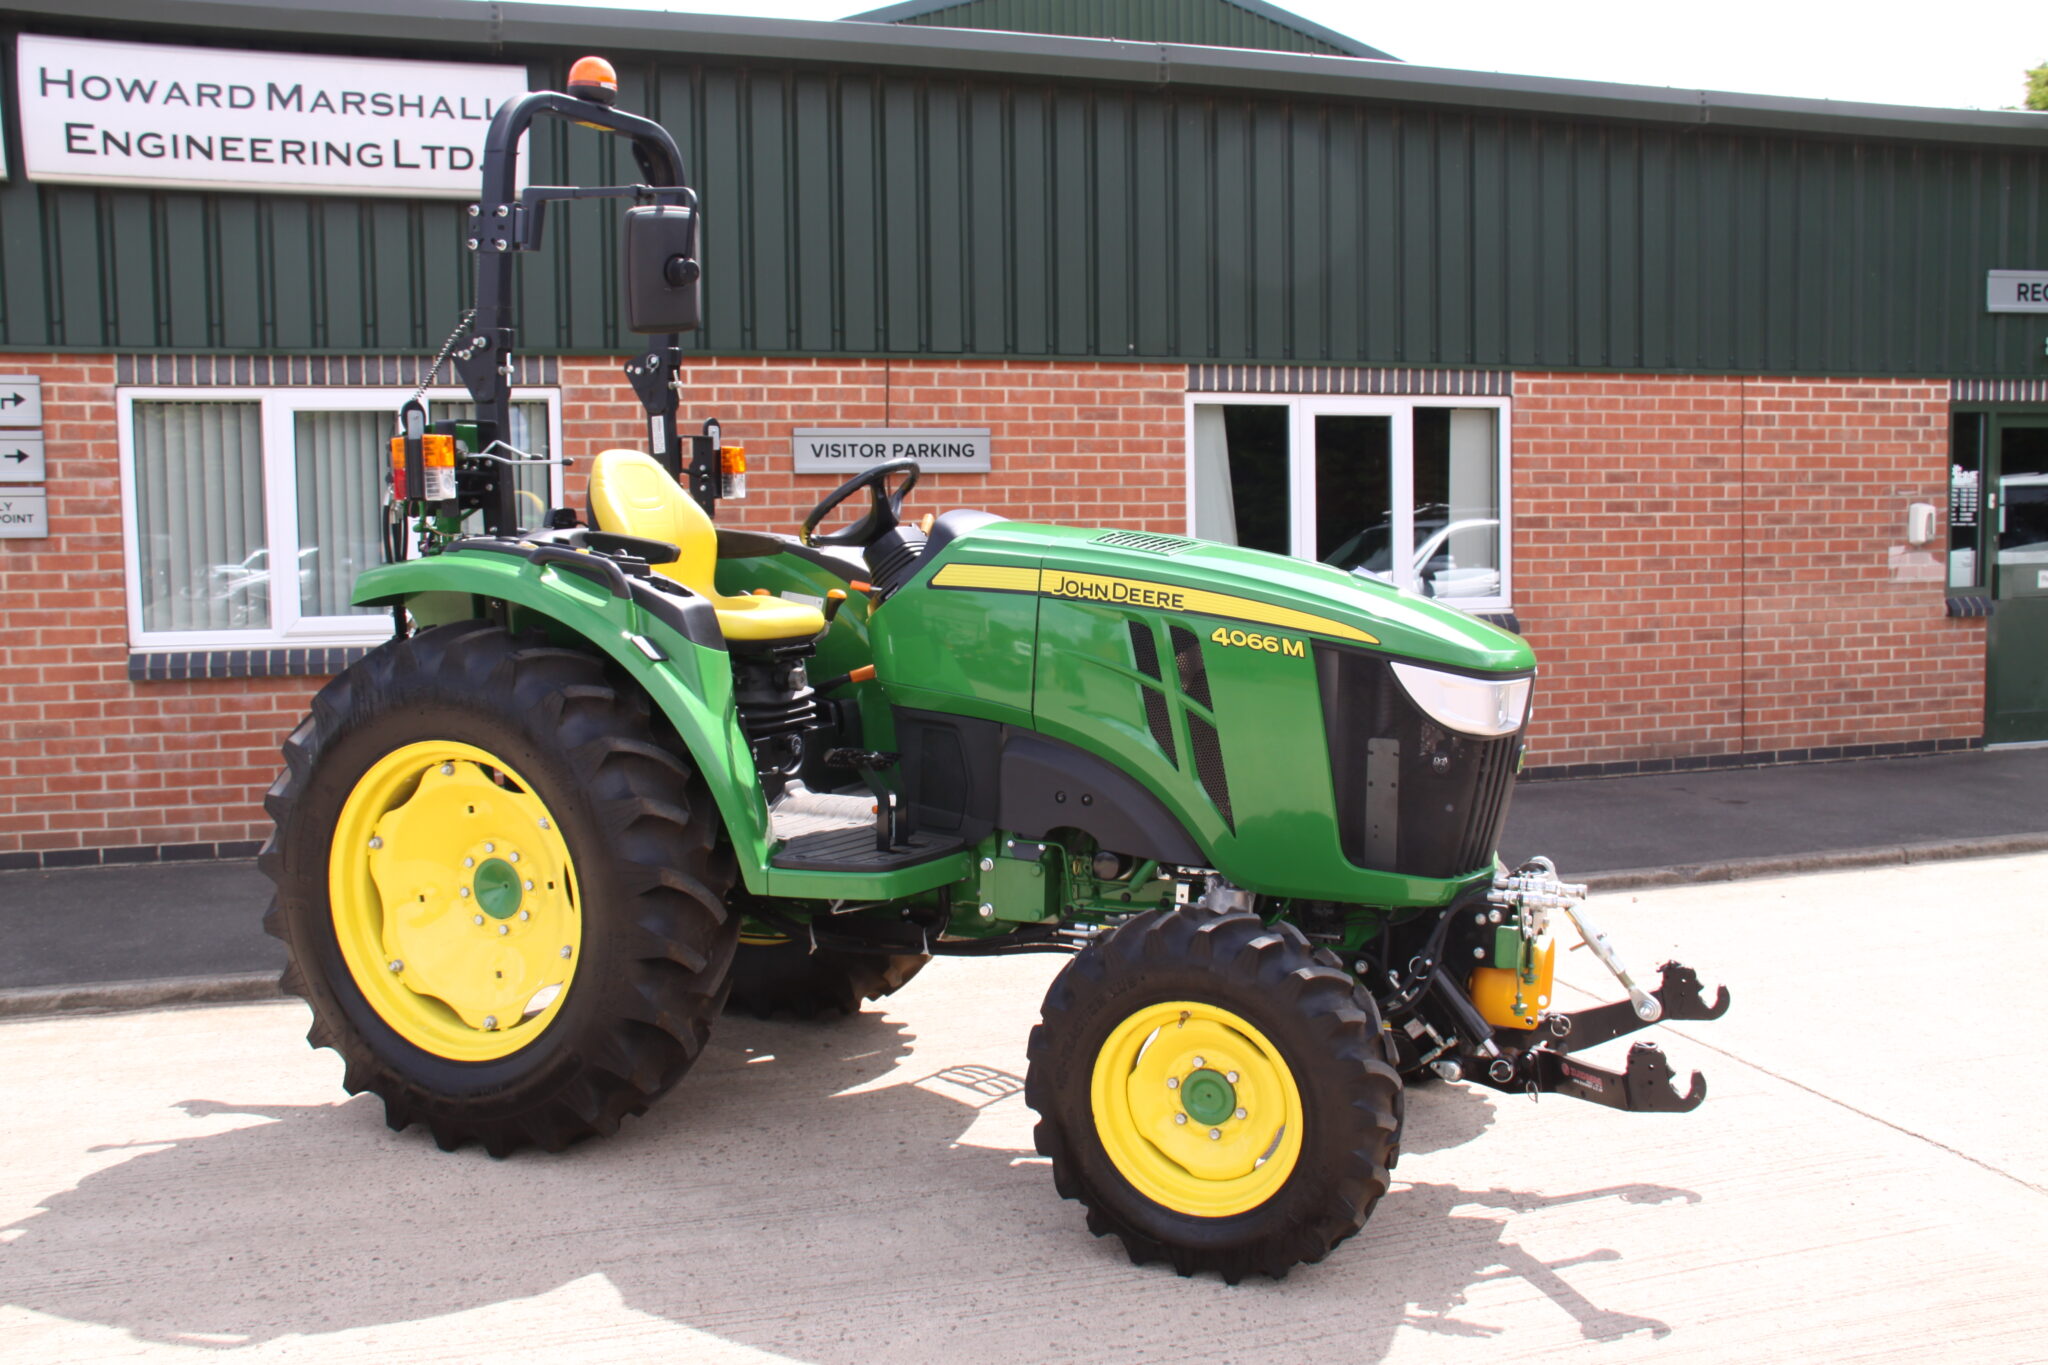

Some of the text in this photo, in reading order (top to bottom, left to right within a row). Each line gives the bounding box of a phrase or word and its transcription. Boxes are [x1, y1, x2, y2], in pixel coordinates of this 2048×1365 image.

[39, 66, 492, 121] HOWARD MARSHALL
[65, 121, 384, 169] ENGINEERING
[811, 443, 975, 458] VISITOR PARKING
[0, 514, 34, 524] OINT
[1053, 576, 1185, 609] JOHN DEERE
